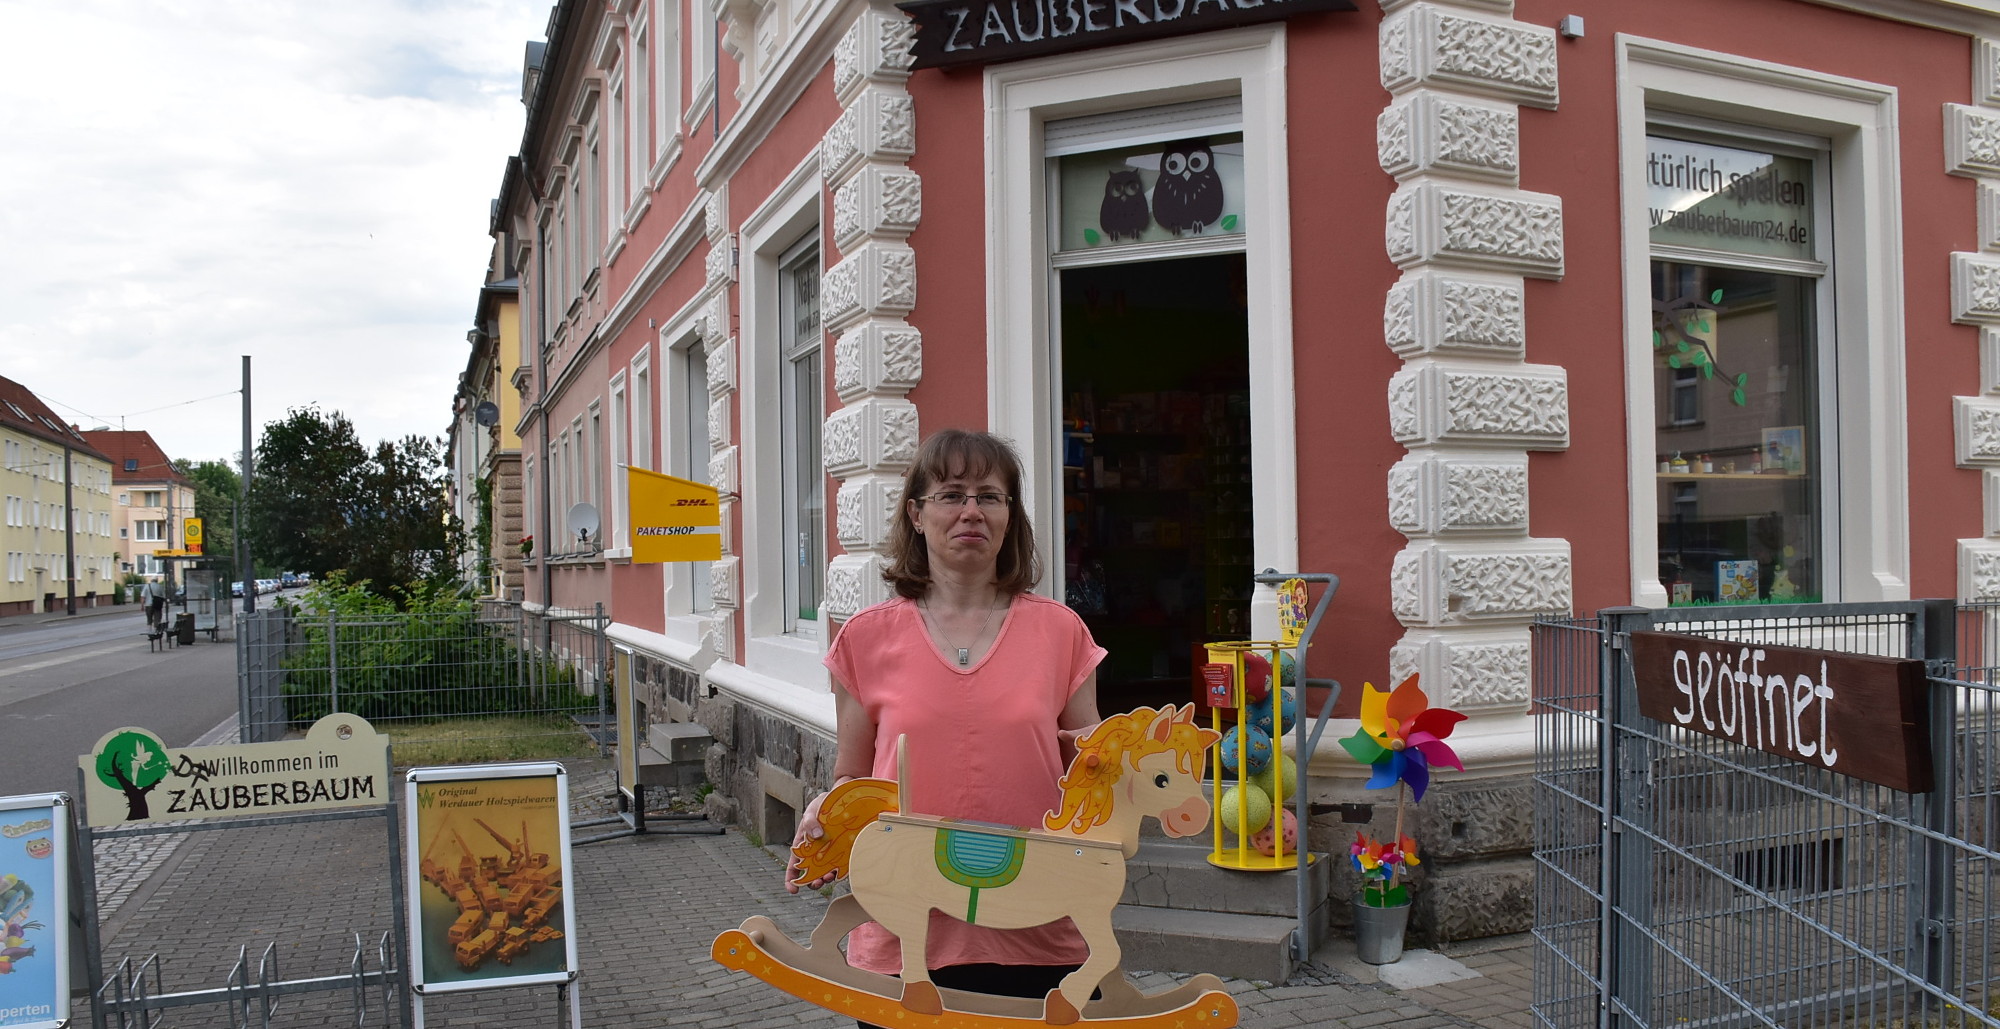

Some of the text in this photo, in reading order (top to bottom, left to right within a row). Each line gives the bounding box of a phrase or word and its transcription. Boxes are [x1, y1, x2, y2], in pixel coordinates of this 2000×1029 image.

[1646, 152, 1805, 206] türlich spielen
[676, 499, 708, 507] DHL
[637, 526, 695, 535] PAKETSHOP
[1673, 647, 1838, 767] geöffnet
[203, 756, 312, 778] Willkommen
[318, 751, 339, 769] im
[166, 775, 376, 814] ZAUBERBAUM
[438, 787, 478, 798] Original
[440, 799, 483, 809] Werdauer
[486, 795, 556, 808] Holzspielwaren
